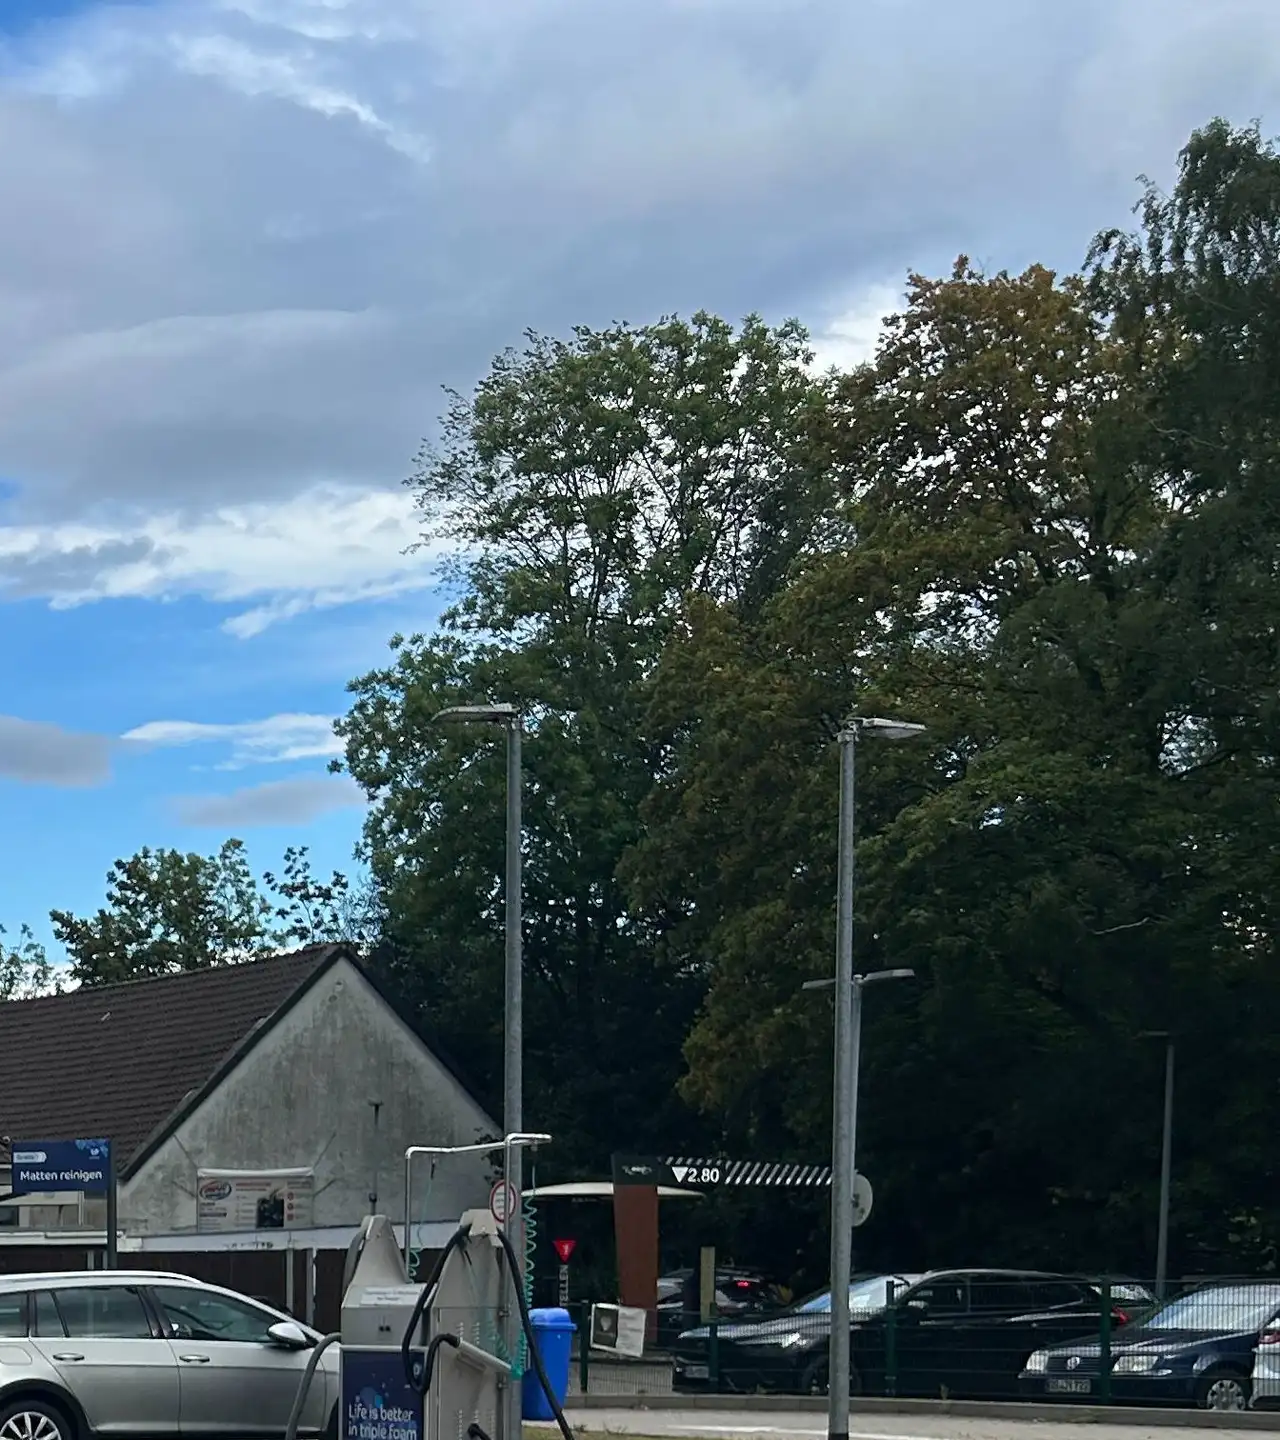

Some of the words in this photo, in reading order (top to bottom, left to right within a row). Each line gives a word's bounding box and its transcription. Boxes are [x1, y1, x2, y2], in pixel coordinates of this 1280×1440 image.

[20, 1170, 58, 1181] Matten
[60, 1169, 102, 1183] reinigen
[687, 1167, 720, 1183] 2.80
[348, 1403, 368, 1420] Life
[368, 1404, 378, 1420] is
[380, 1404, 414, 1422] better
[348, 1421, 358, 1436] in
[359, 1422, 387, 1440] triple
[388, 1423, 417, 1440] foam
